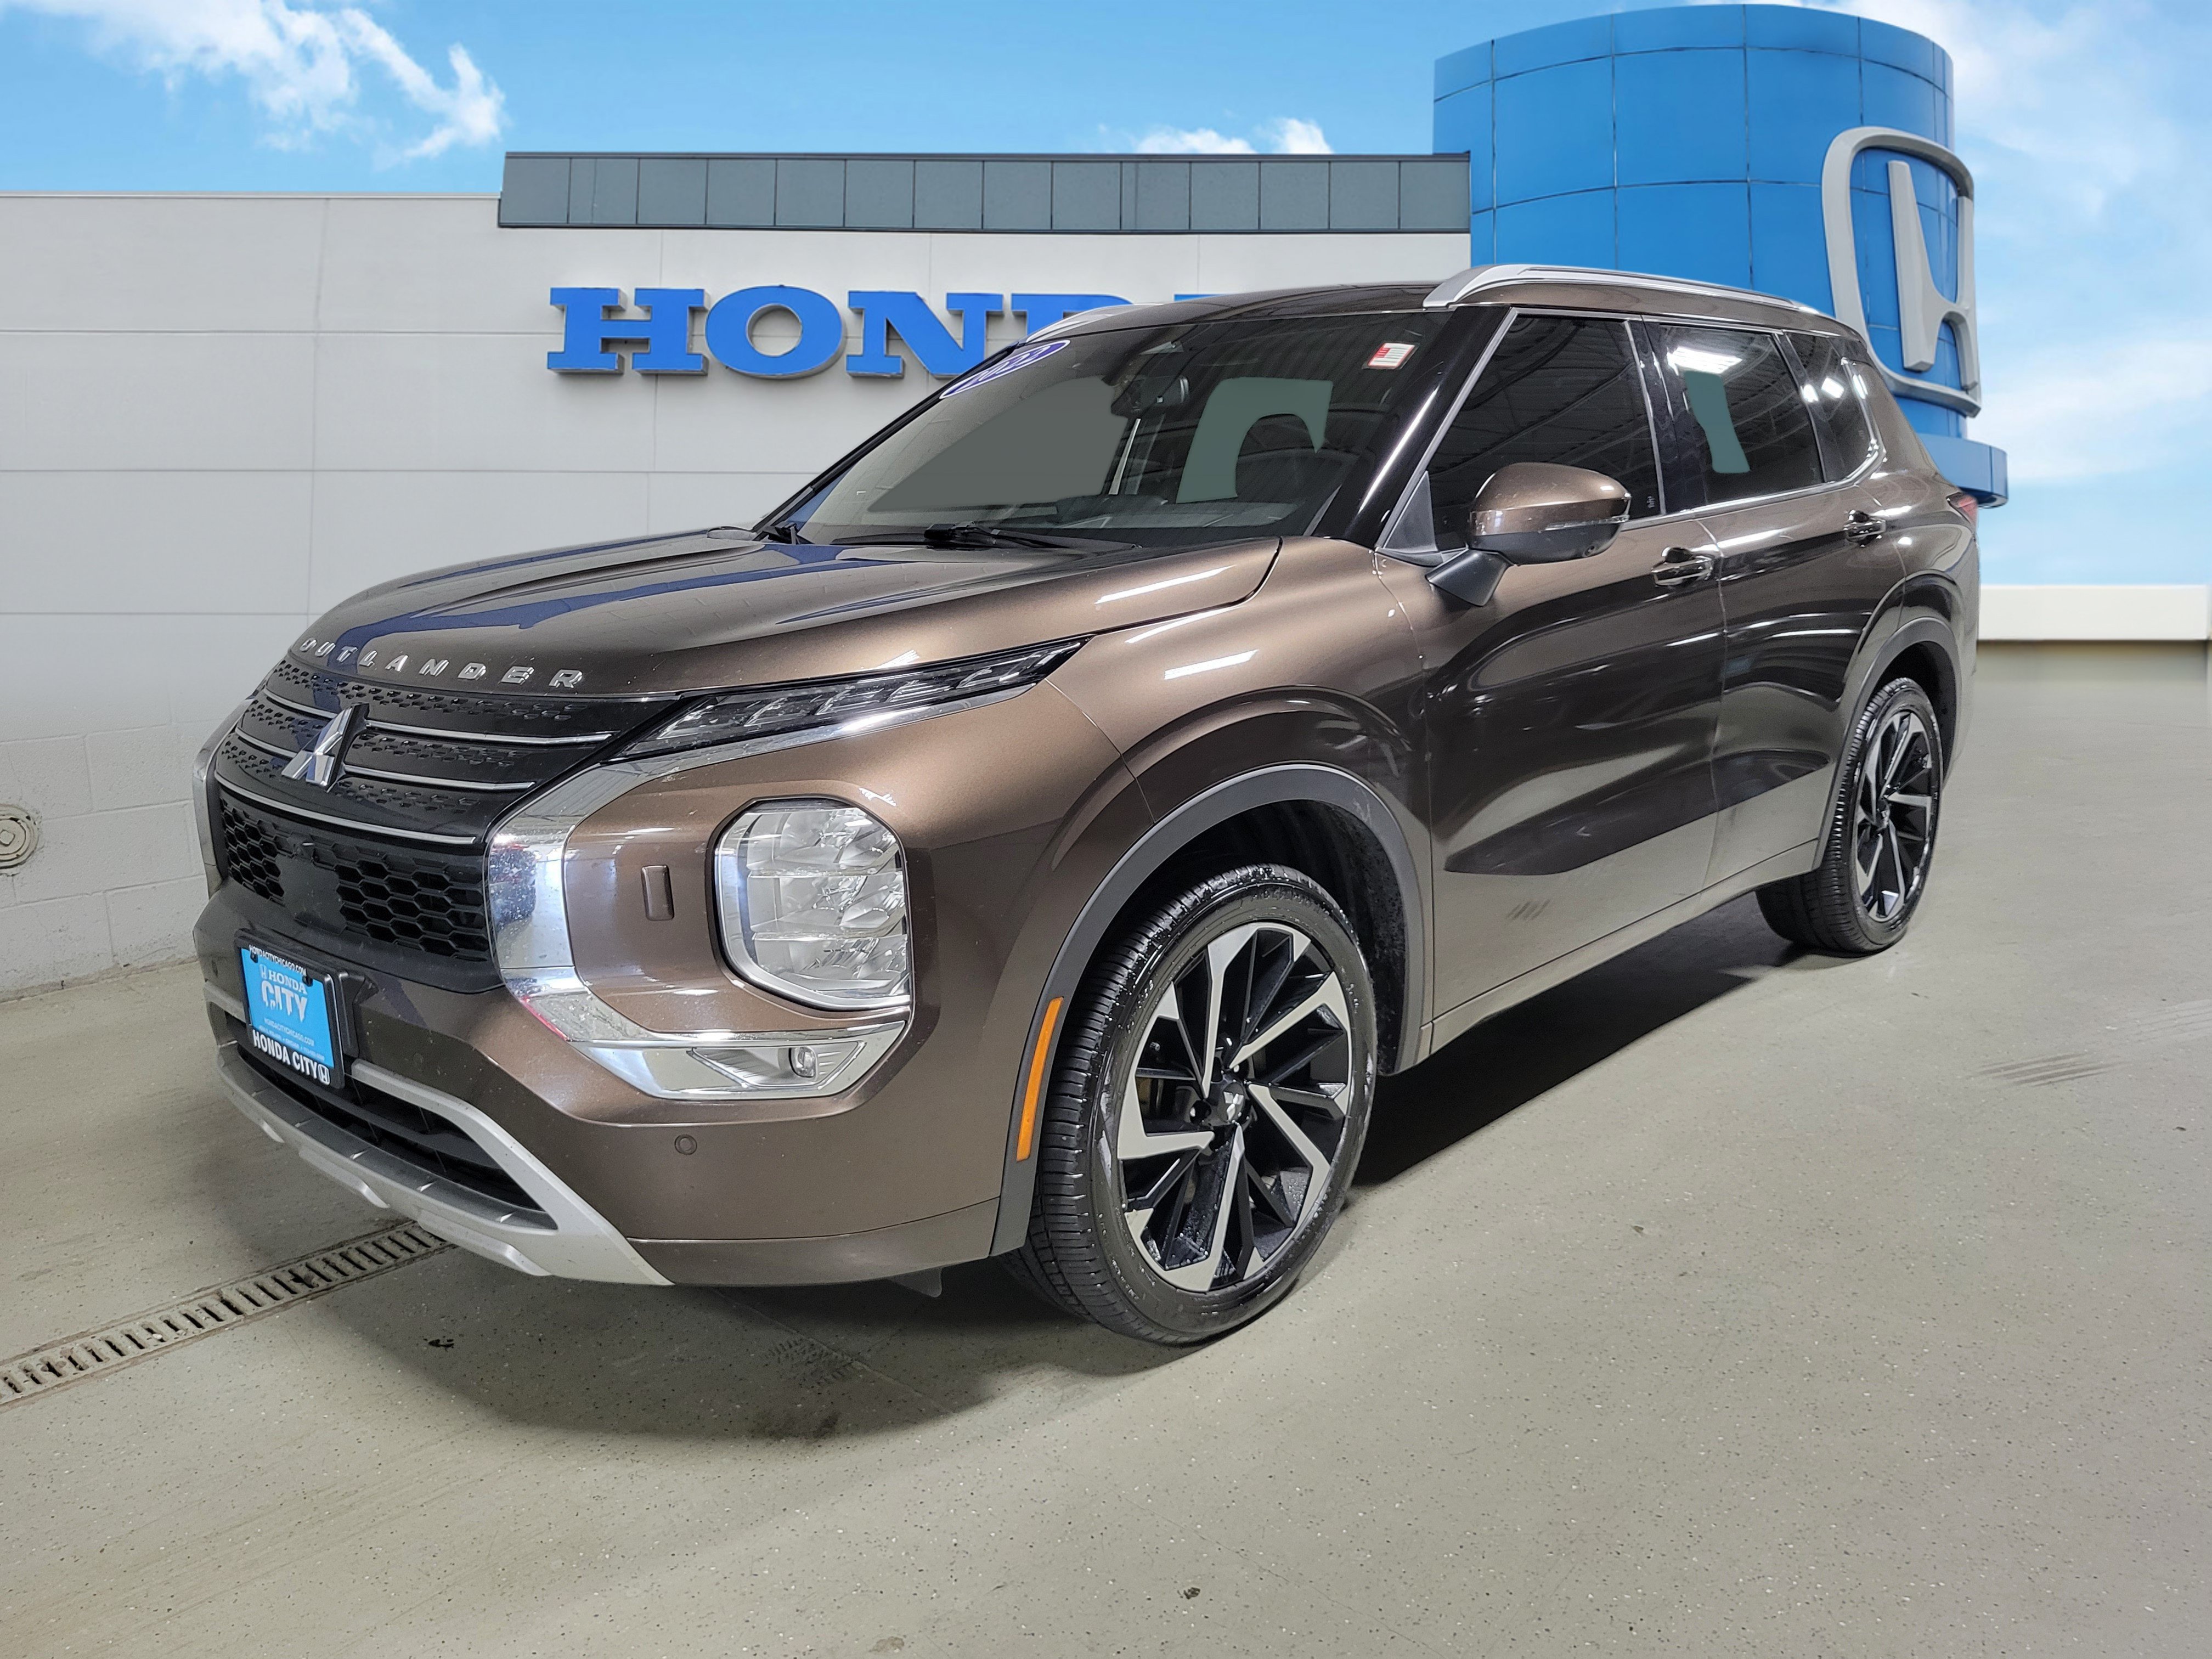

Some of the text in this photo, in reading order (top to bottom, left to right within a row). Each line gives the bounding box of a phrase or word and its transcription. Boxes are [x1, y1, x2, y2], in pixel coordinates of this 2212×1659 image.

[547, 284, 1232, 380] HON
[300, 637, 584, 689] OUTLANDER
[249, 944, 307, 977] HONDACITYCHICAGO.COM
[268, 969, 308, 995] HONDA
[262, 980, 308, 1022] CITY
[252, 1029, 291, 1065] HONDA
[292, 1051, 318, 1079] CITY
